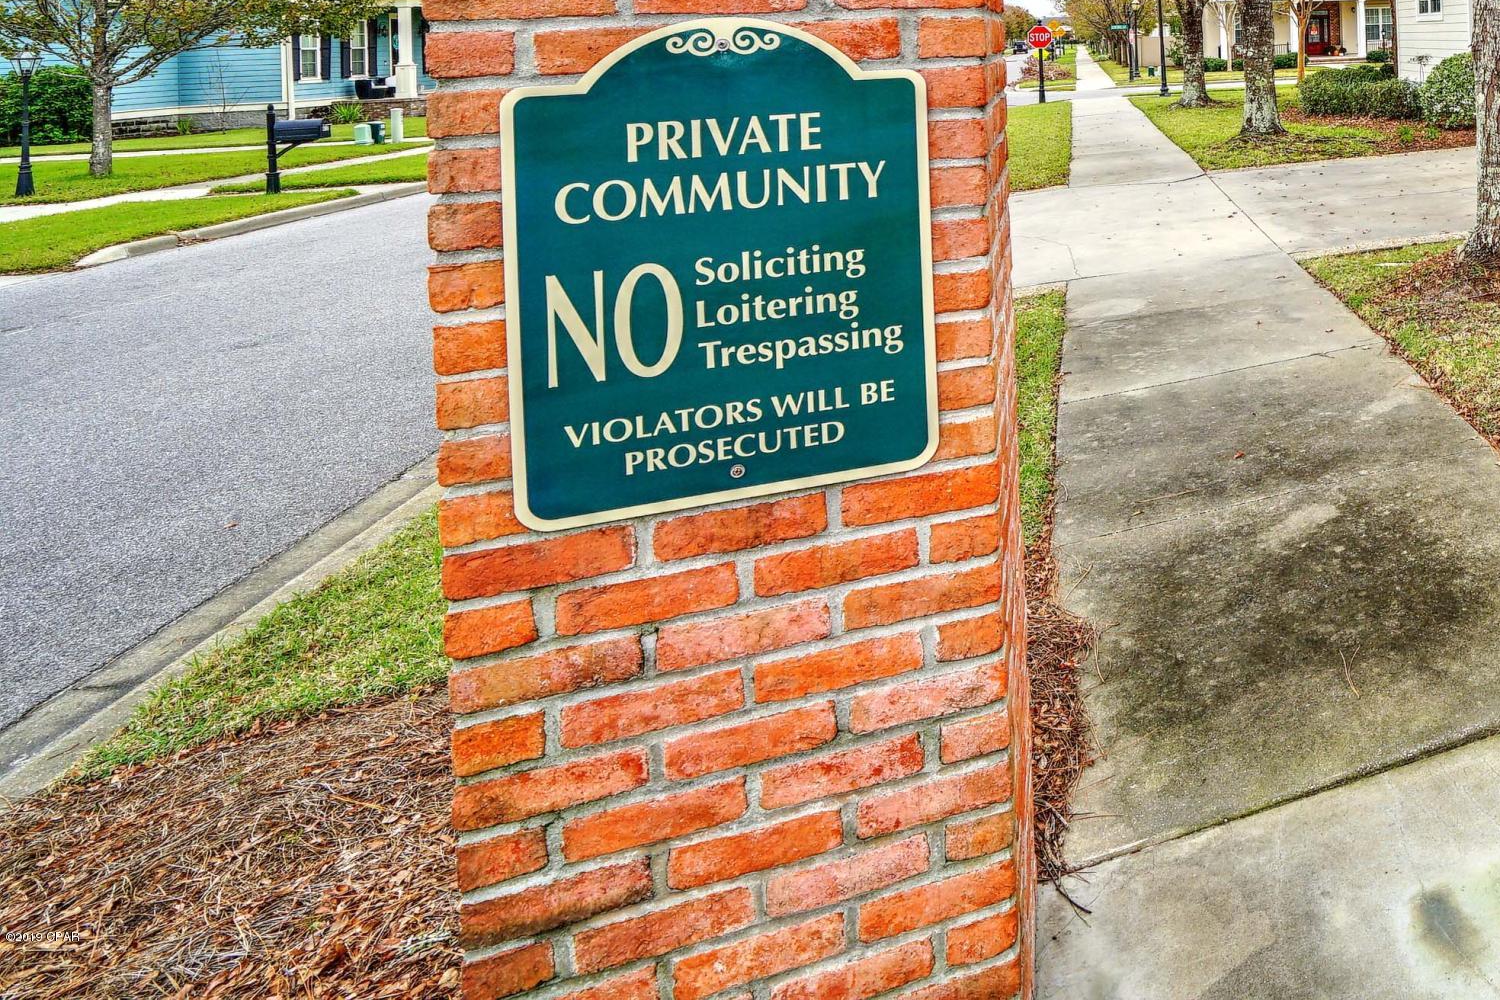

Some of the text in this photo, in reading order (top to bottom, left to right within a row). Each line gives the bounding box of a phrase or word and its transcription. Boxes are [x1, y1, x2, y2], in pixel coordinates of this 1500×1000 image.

[1030, 32, 1050, 42] STOP
[626, 112, 822, 163] PRIVATE
[555, 160, 886, 225] COMMUNITY
[694, 244, 866, 287] Soliciting
[545, 263, 684, 389] NO
[696, 286, 858, 328] Loitering
[698, 322, 904, 369] Trespassing
[564, 379, 895, 448] VIOLATORS WILL BE
[624, 421, 845, 475] PROSECUTED
